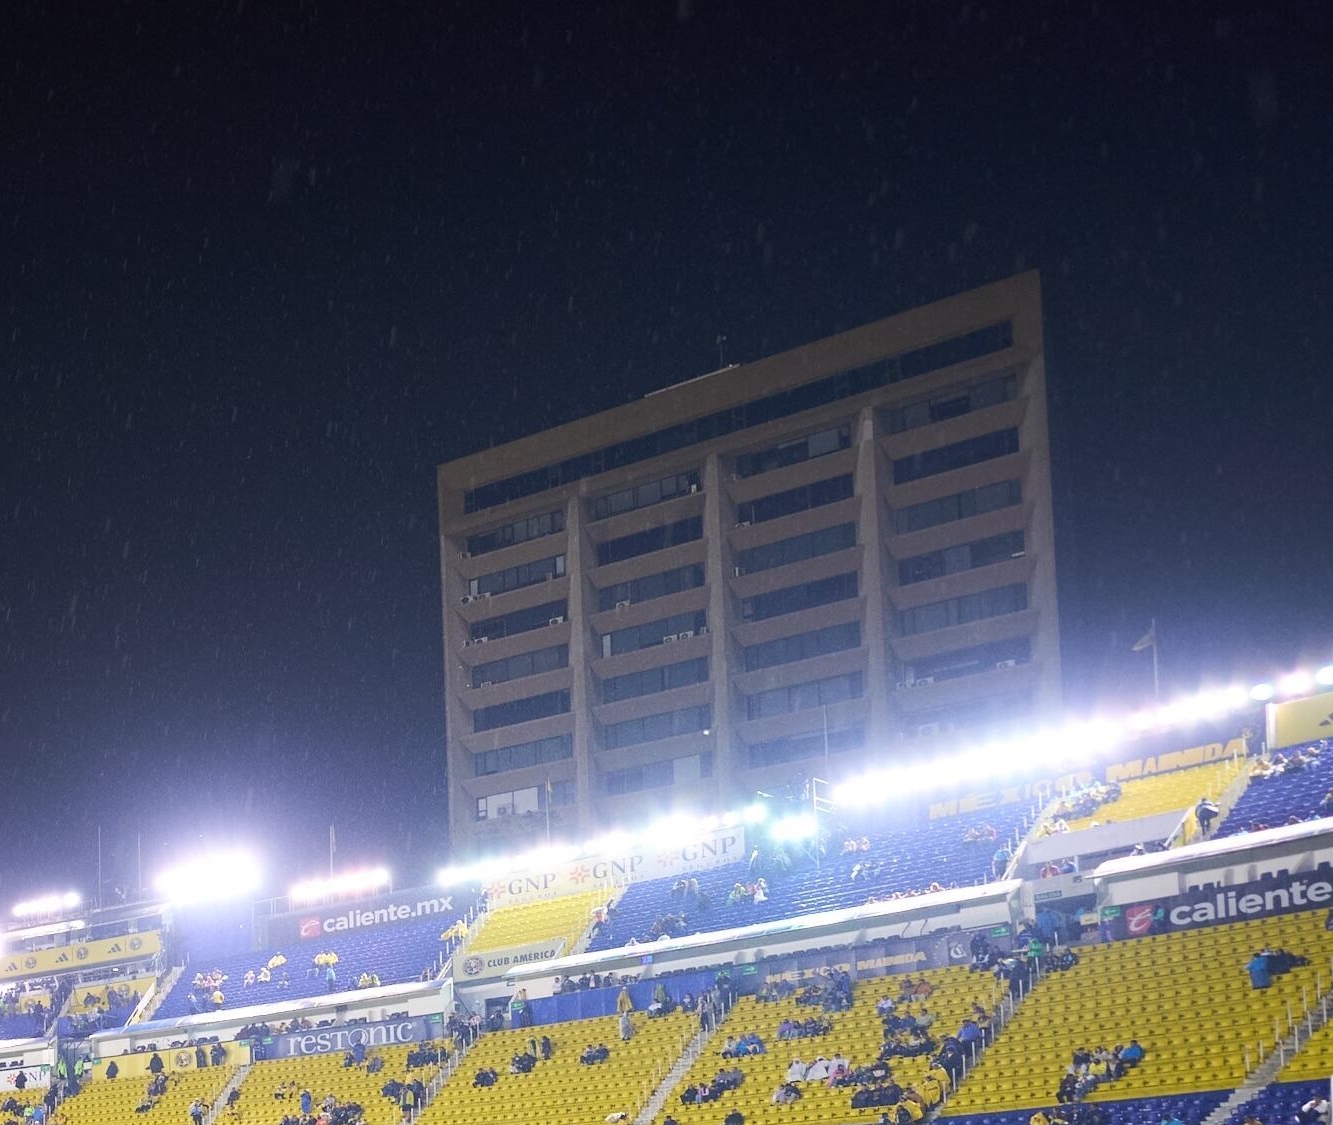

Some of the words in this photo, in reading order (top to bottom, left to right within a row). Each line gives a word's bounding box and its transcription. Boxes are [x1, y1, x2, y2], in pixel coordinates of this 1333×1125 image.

[681, 836, 737, 862] GNP
[593, 855, 643, 879] GNP
[508, 873, 557, 896] GNP
[323, 895, 454, 933] caliente.mx
[487, 956, 510, 968] CLUB
[513, 949, 556, 964] AMÉRICA
